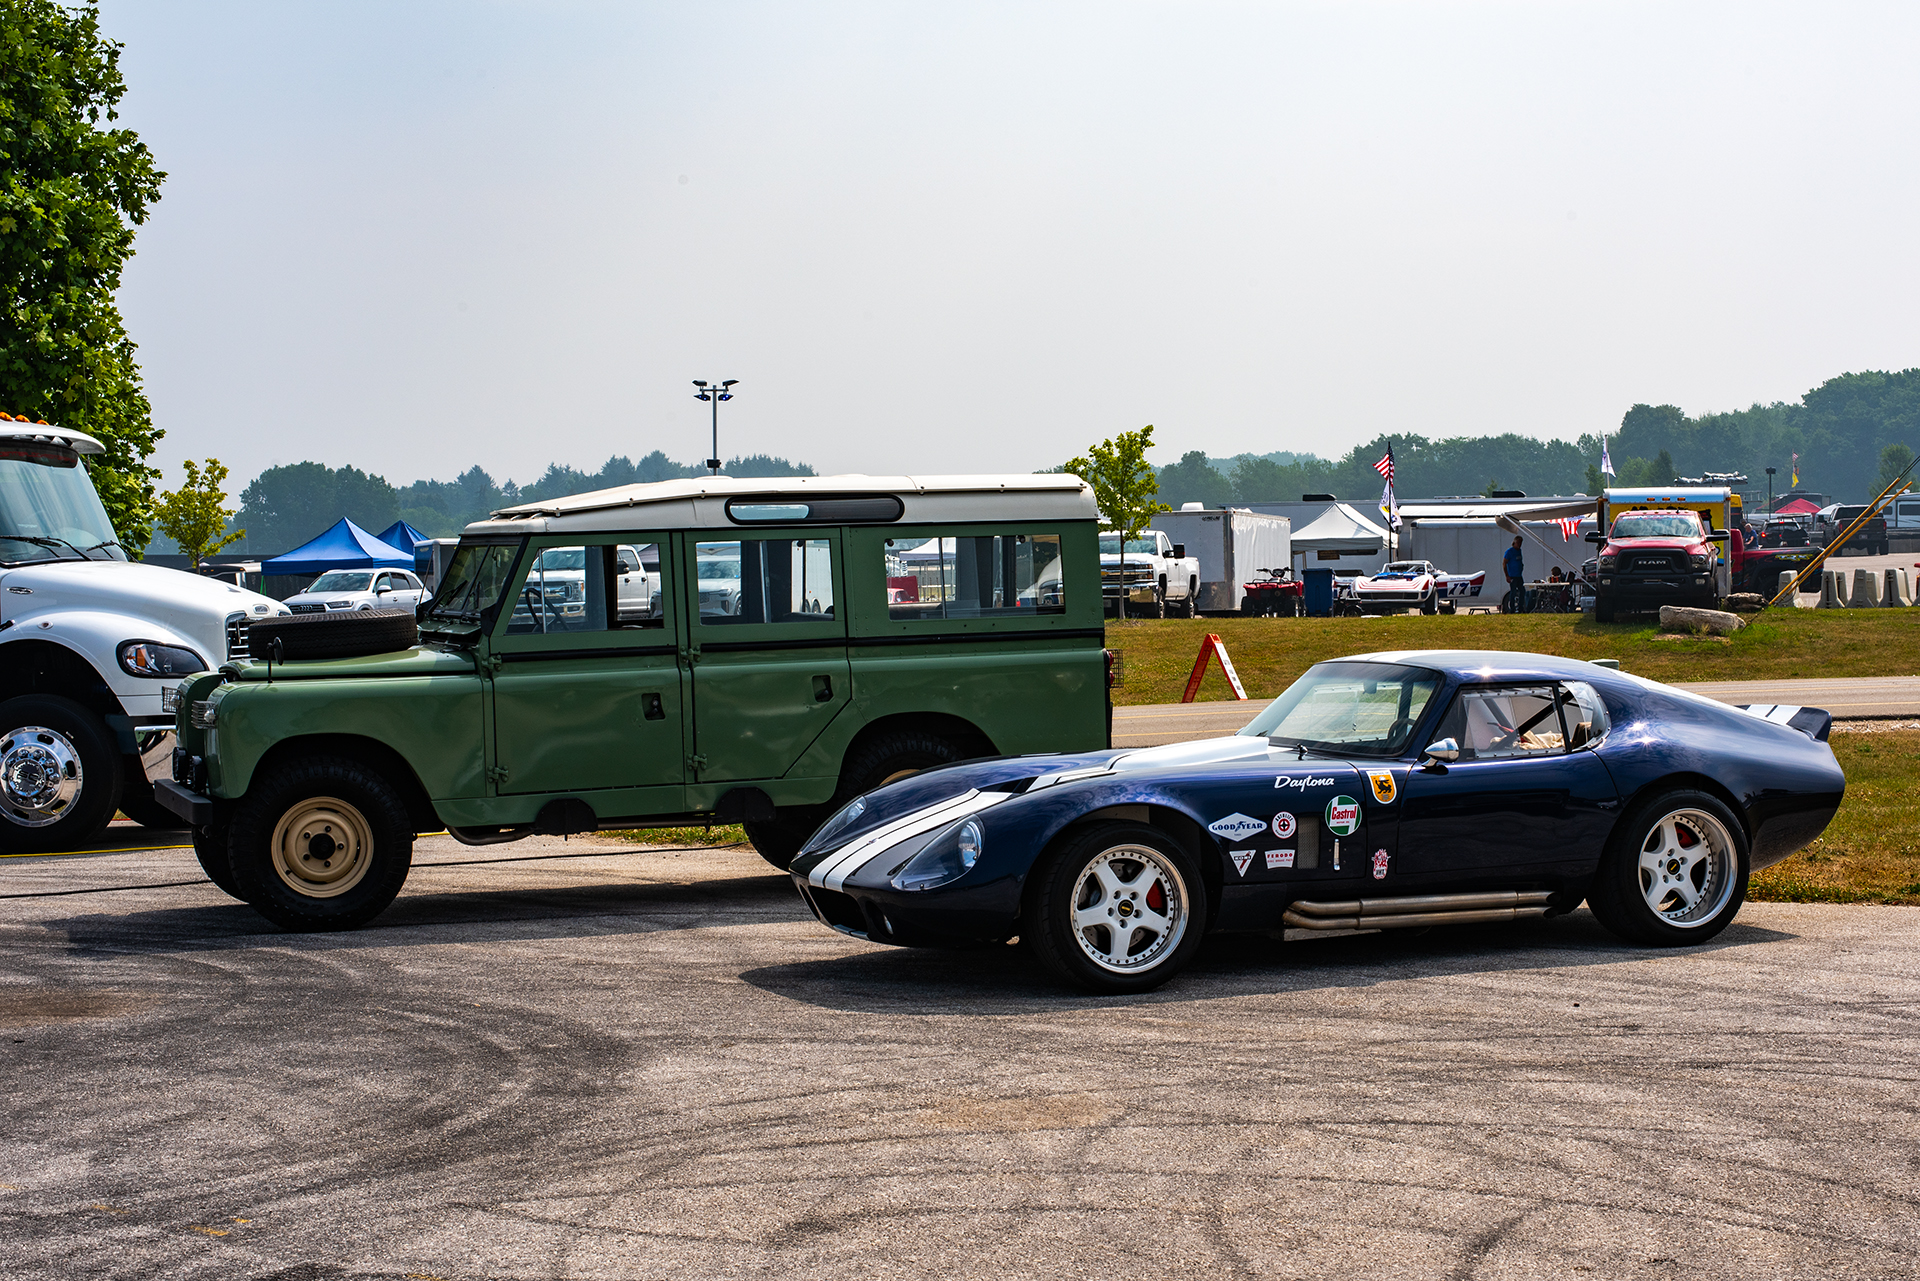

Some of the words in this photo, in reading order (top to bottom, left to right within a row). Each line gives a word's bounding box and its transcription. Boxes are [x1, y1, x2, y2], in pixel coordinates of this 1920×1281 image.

[1448, 582, 1470, 596] 77
[1274, 774, 1335, 793] Daytona
[1331, 805, 1357, 820] Castrol
